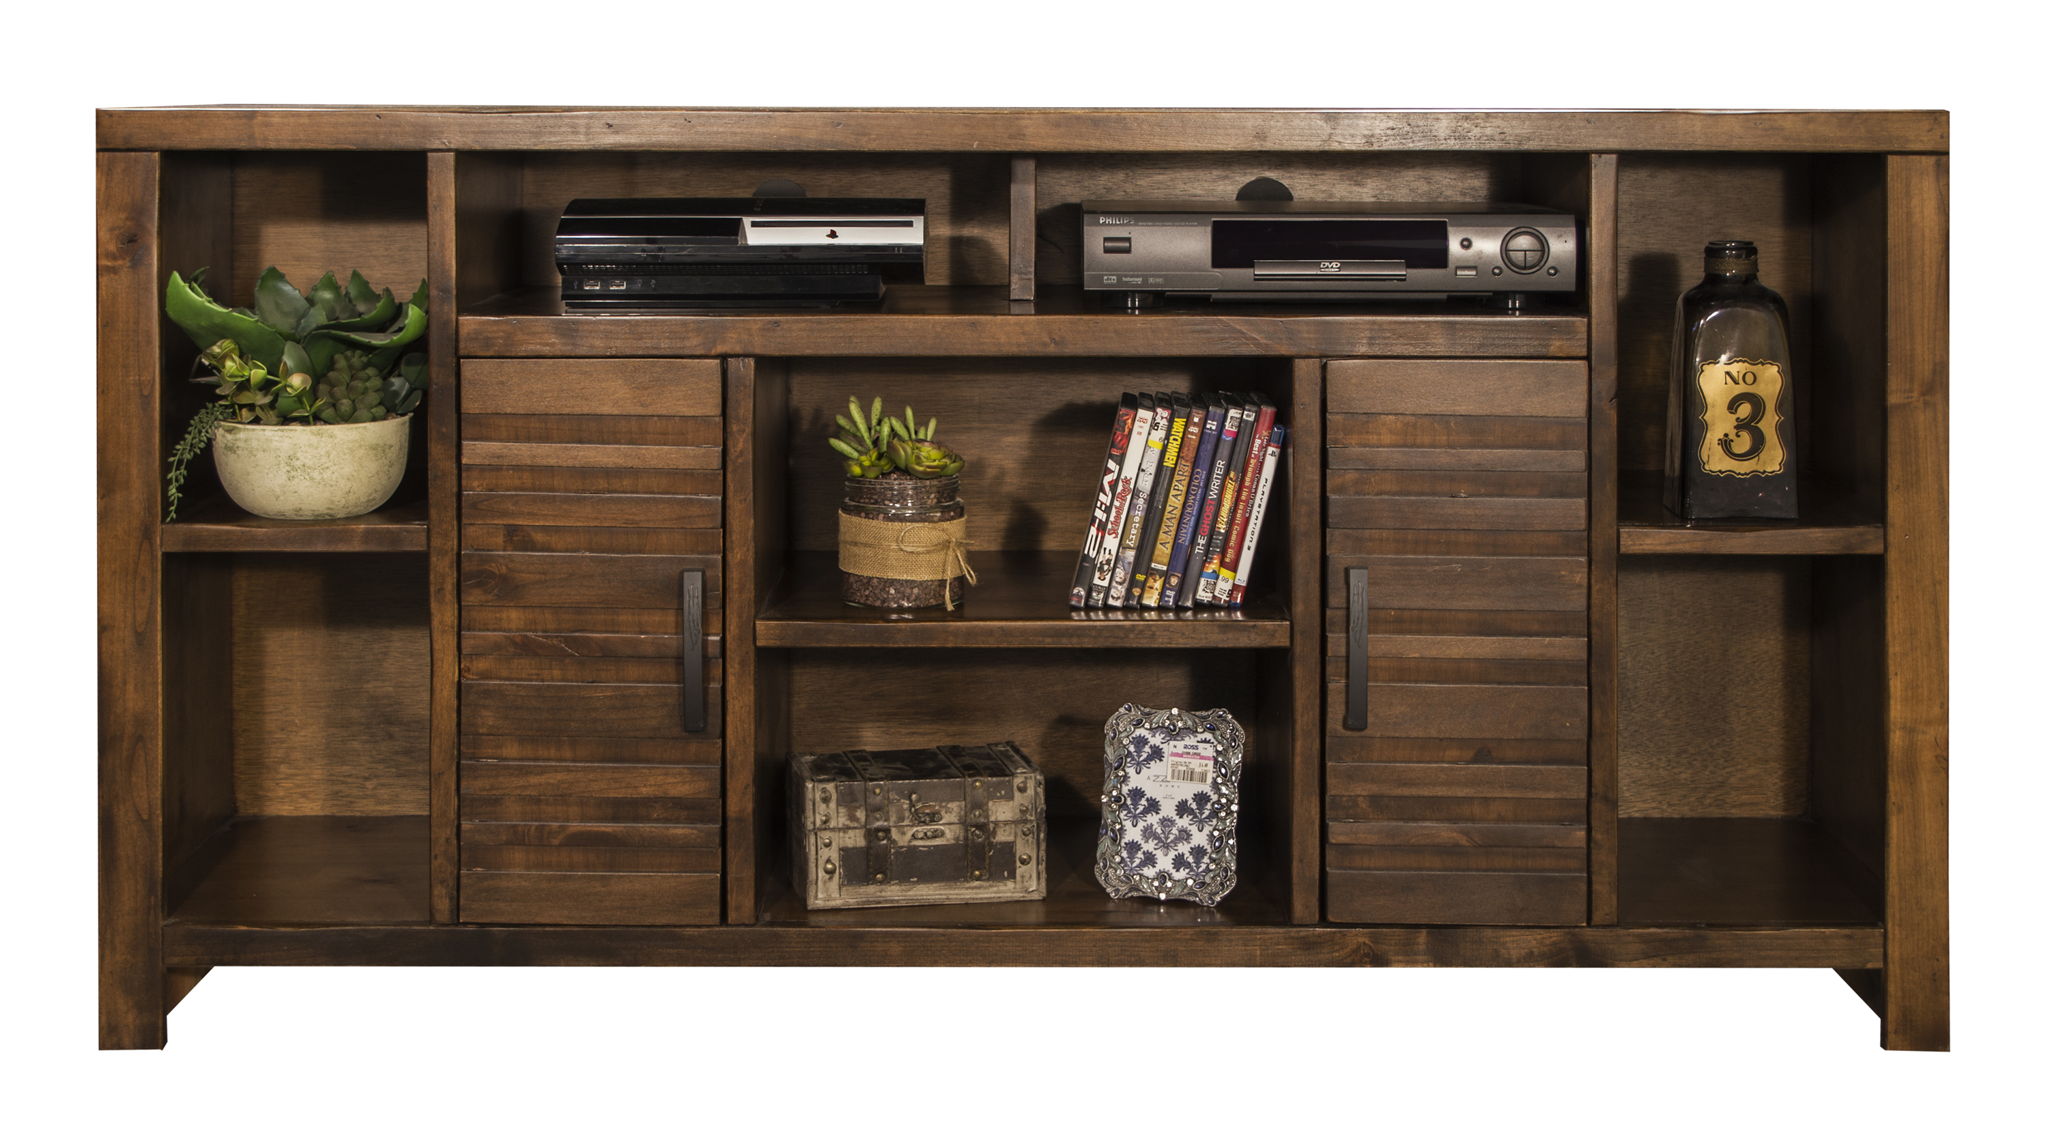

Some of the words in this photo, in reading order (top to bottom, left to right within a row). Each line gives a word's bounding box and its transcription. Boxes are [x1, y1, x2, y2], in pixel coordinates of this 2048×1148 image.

[1100, 216, 1134, 225] PHILIPS
[1320, 261, 1341, 269] DVD
[1724, 370, 1757, 386] NO
[1717, 391, 1767, 462] 3
[1163, 417, 1187, 468] WATCHMEN
[1252, 439, 1262, 454] Best
[1171, 462, 1191, 503] APART
[1189, 468, 1203, 494] COLD
[1208, 460, 1226, 499] WRITER
[1245, 459, 1257, 487] Triumph
[1107, 504, 1123, 539] School
[1115, 475, 1133, 503] Rock
[1126, 491, 1148, 547] Secretary
[1162, 504, 1179, 537] MAN
[1177, 494, 1197, 545] MOUNTAIN
[1200, 499, 1216, 536] GHOST
[1235, 502, 1246, 524] Insult
[1248, 477, 1268, 543] PLAYSTATION
[1158, 540, 1171, 551] A
[1195, 534, 1208, 554] THE
[1229, 525, 1240, 548] Comic
